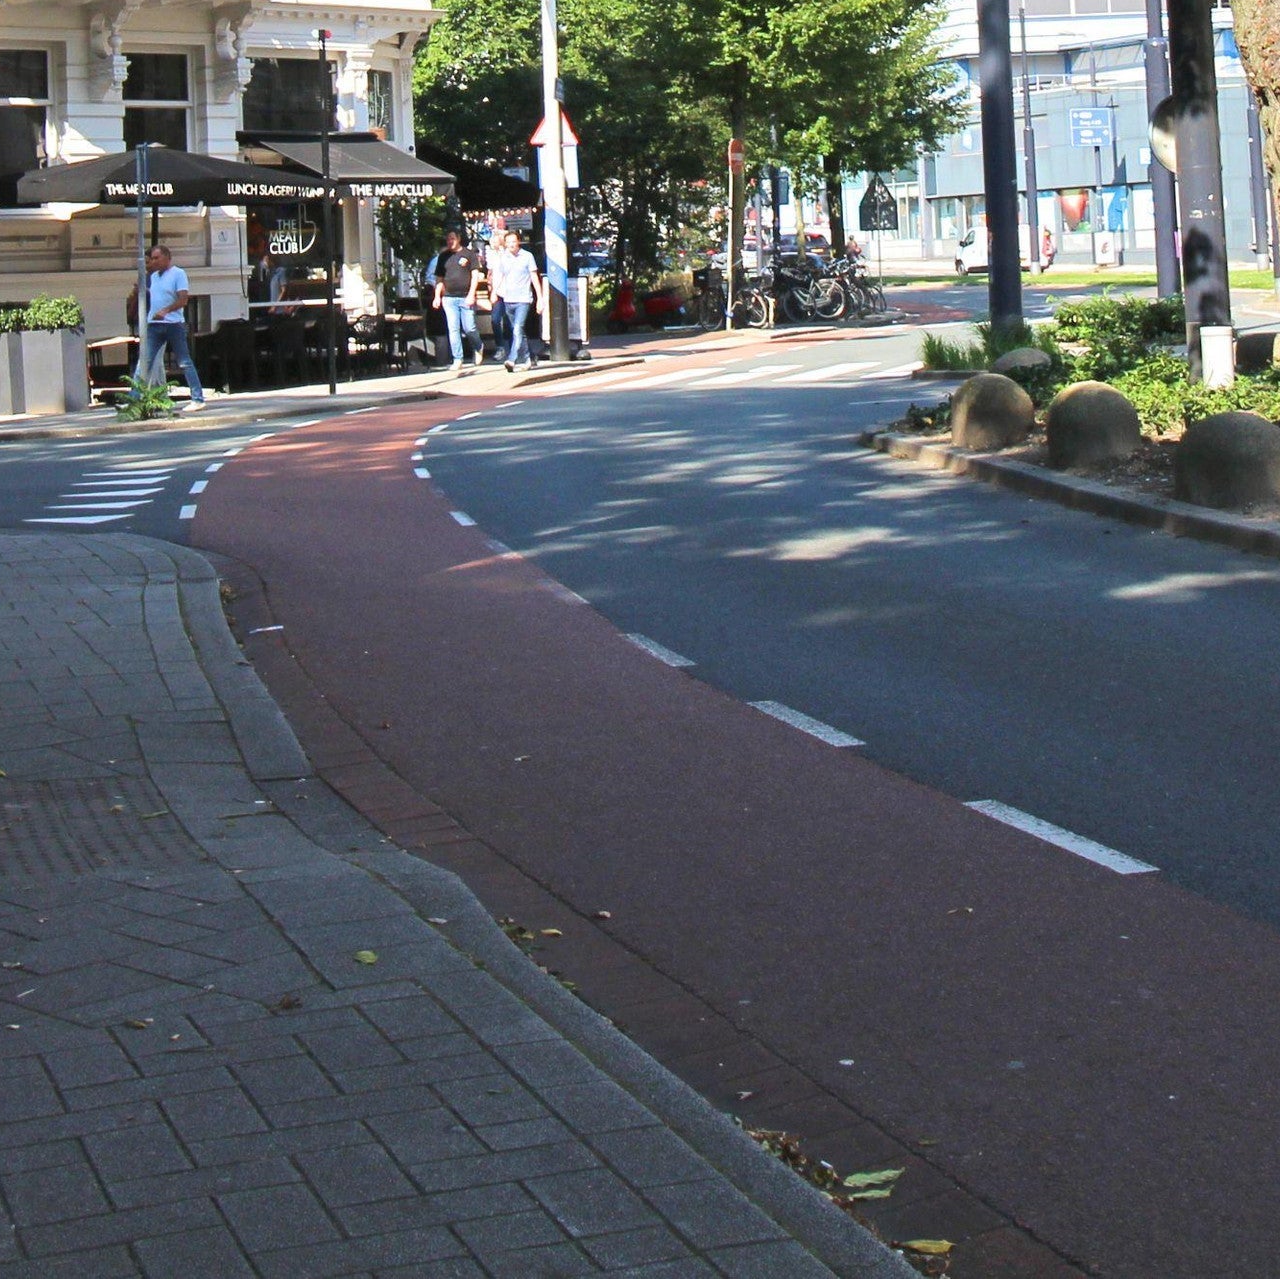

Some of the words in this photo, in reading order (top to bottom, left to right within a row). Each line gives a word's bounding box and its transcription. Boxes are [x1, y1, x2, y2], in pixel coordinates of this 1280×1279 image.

[105, 183, 126, 196] THE
[227, 183, 258, 196] LUNCH
[349, 183, 373, 196] THE
[375, 183, 433, 197] MEATCLUB
[276, 219, 297, 230] THE
[269, 230, 298, 242] MEAT
[269, 242, 298, 255] CLUB
